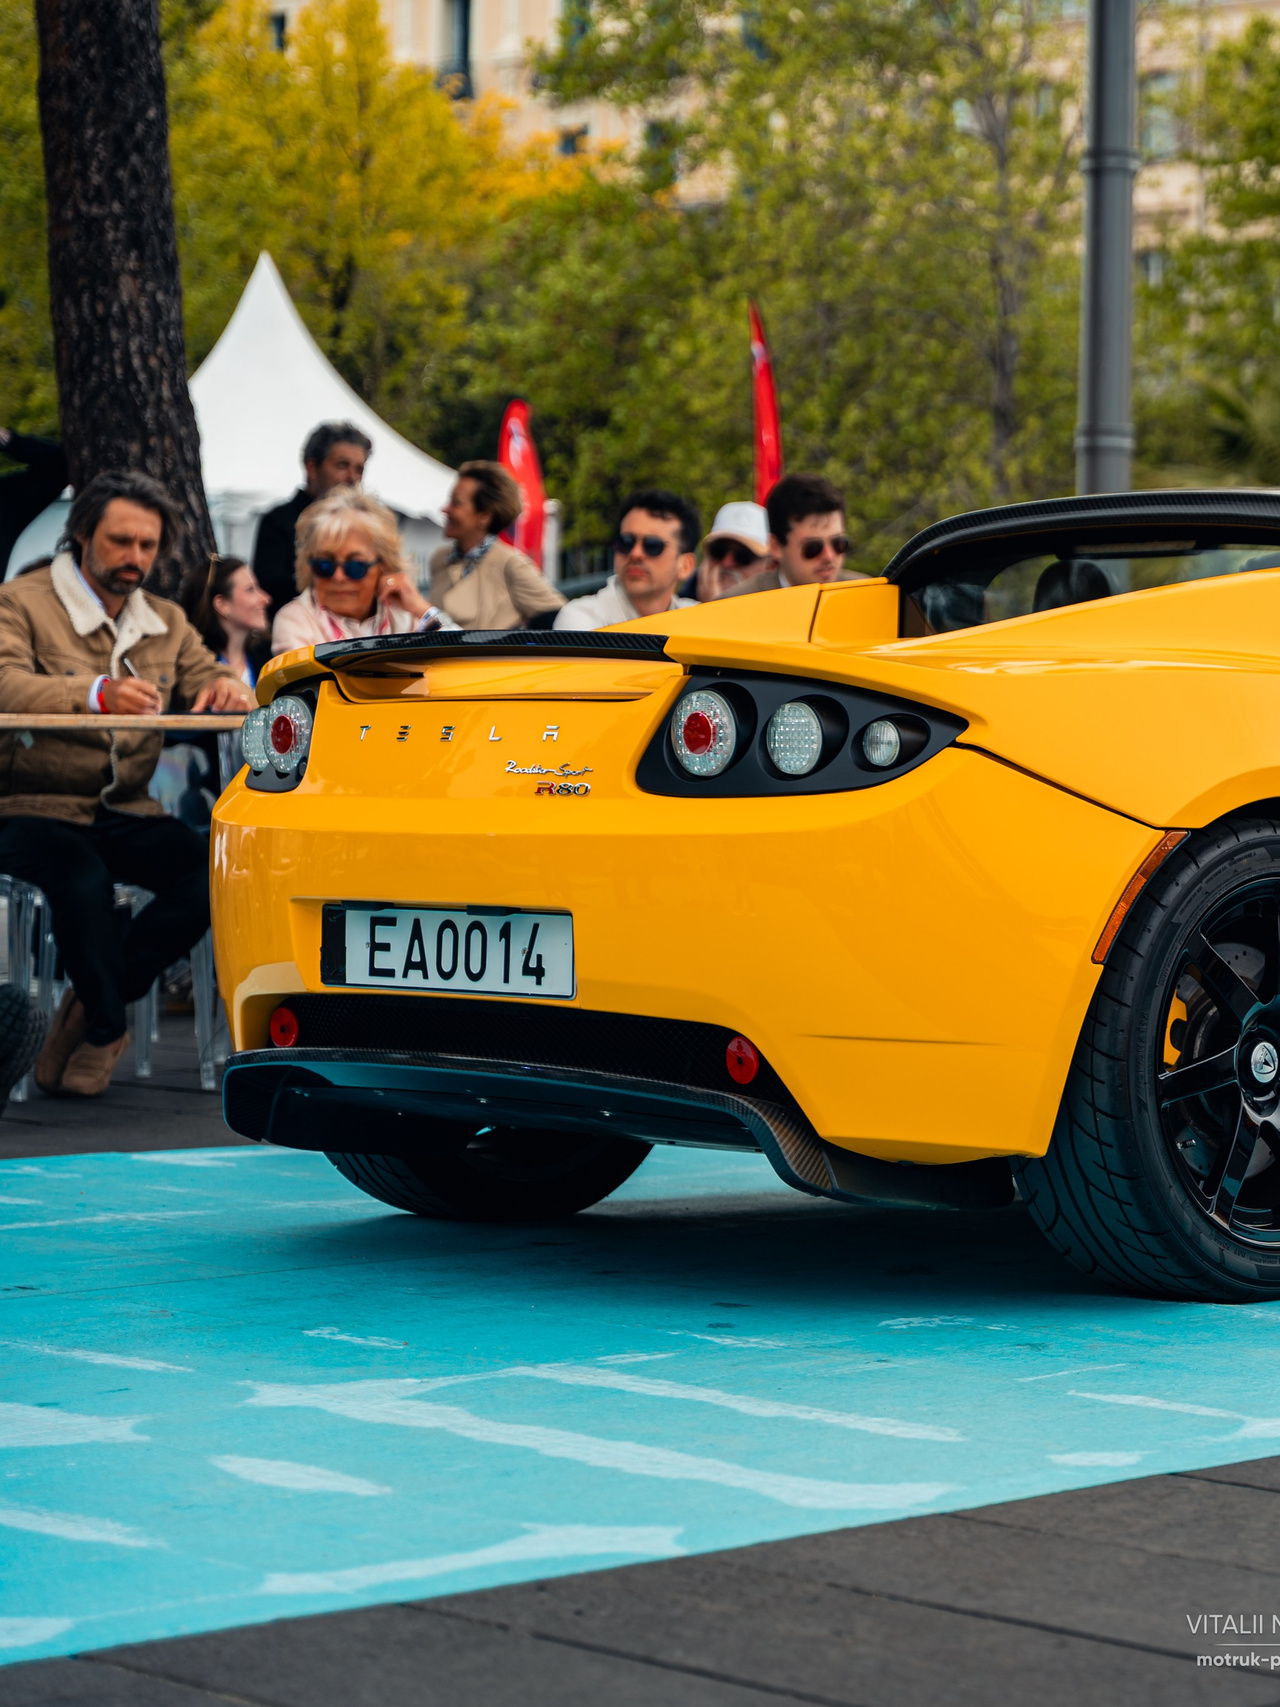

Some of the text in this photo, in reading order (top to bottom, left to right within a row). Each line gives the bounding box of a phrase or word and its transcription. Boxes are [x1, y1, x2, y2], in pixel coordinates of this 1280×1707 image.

[360, 725, 560, 742] TESLA
[534, 780, 592, 797] R80
[368, 915, 546, 986] EA0014
